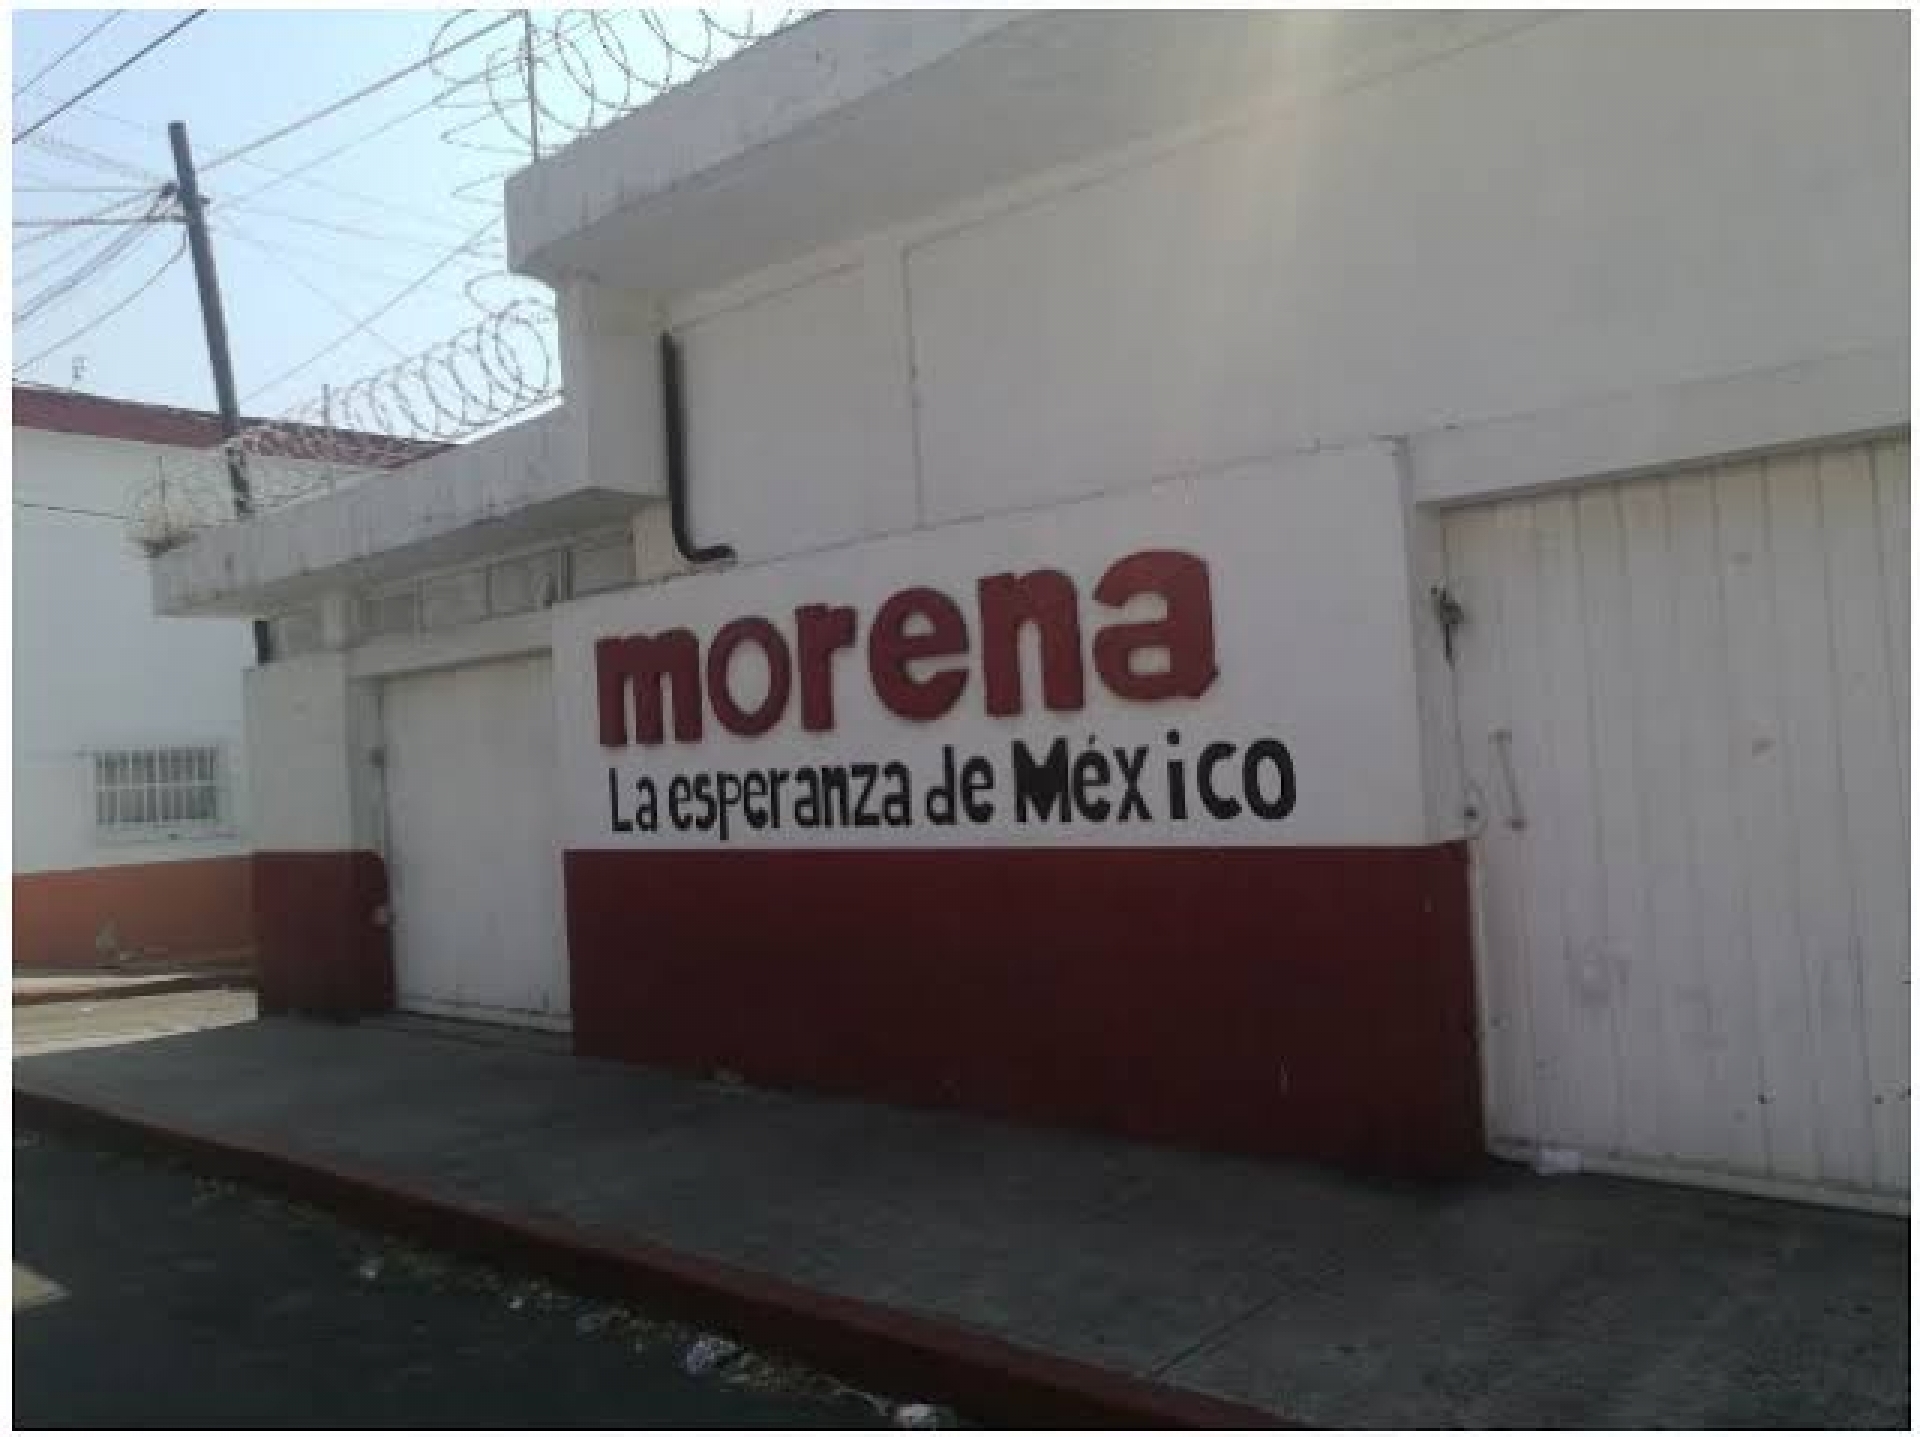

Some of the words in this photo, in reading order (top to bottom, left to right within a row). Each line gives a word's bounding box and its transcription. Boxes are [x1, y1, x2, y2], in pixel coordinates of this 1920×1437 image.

[595, 549, 1219, 747] morena
[609, 767, 658, 832] La
[668, 761, 912, 840] esperanza
[926, 744, 995, 827] de
[1012, 729, 1297, 824] México
